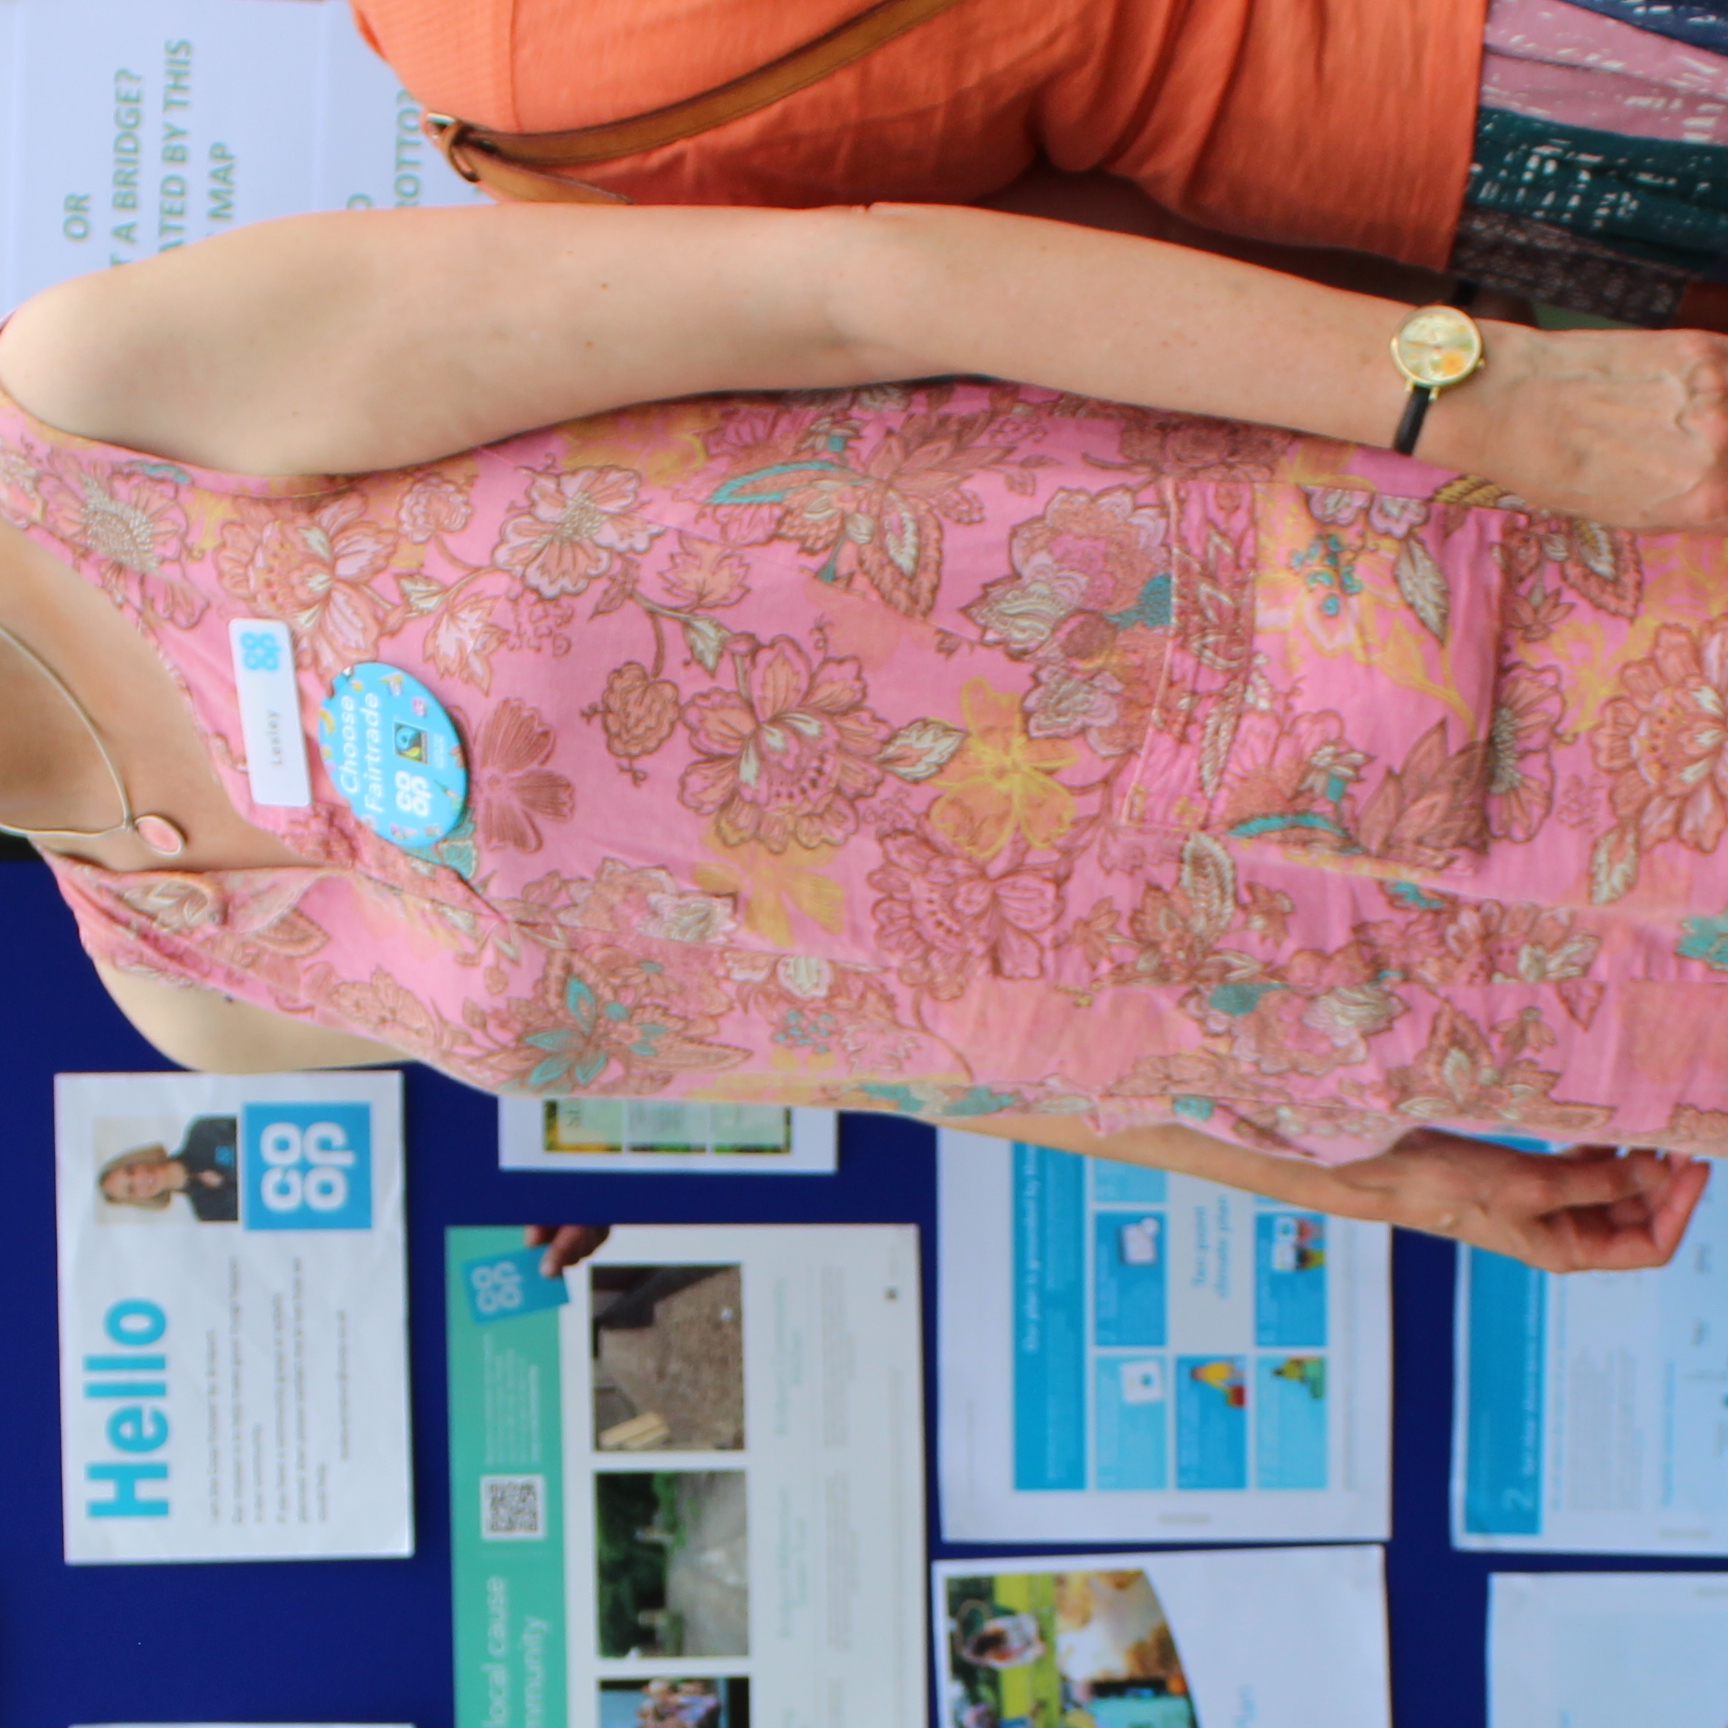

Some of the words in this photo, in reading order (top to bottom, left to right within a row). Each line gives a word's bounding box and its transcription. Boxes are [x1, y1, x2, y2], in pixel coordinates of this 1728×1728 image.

[161, 38, 193, 114] THIS
[111, 67, 145, 212] BRIDGE?
[159, 120, 189, 165] BY
[62, 192, 92, 242] OR
[205, 141, 236, 223] MAP
[109, 221, 138, 245] A
[337, 695, 360, 795] Choose
[359, 692, 385, 813] Fairtrade
[80, 1298, 170, 1521] Hello
[485, 1576, 508, 1656] cause
[481, 1662, 508, 1727] local
